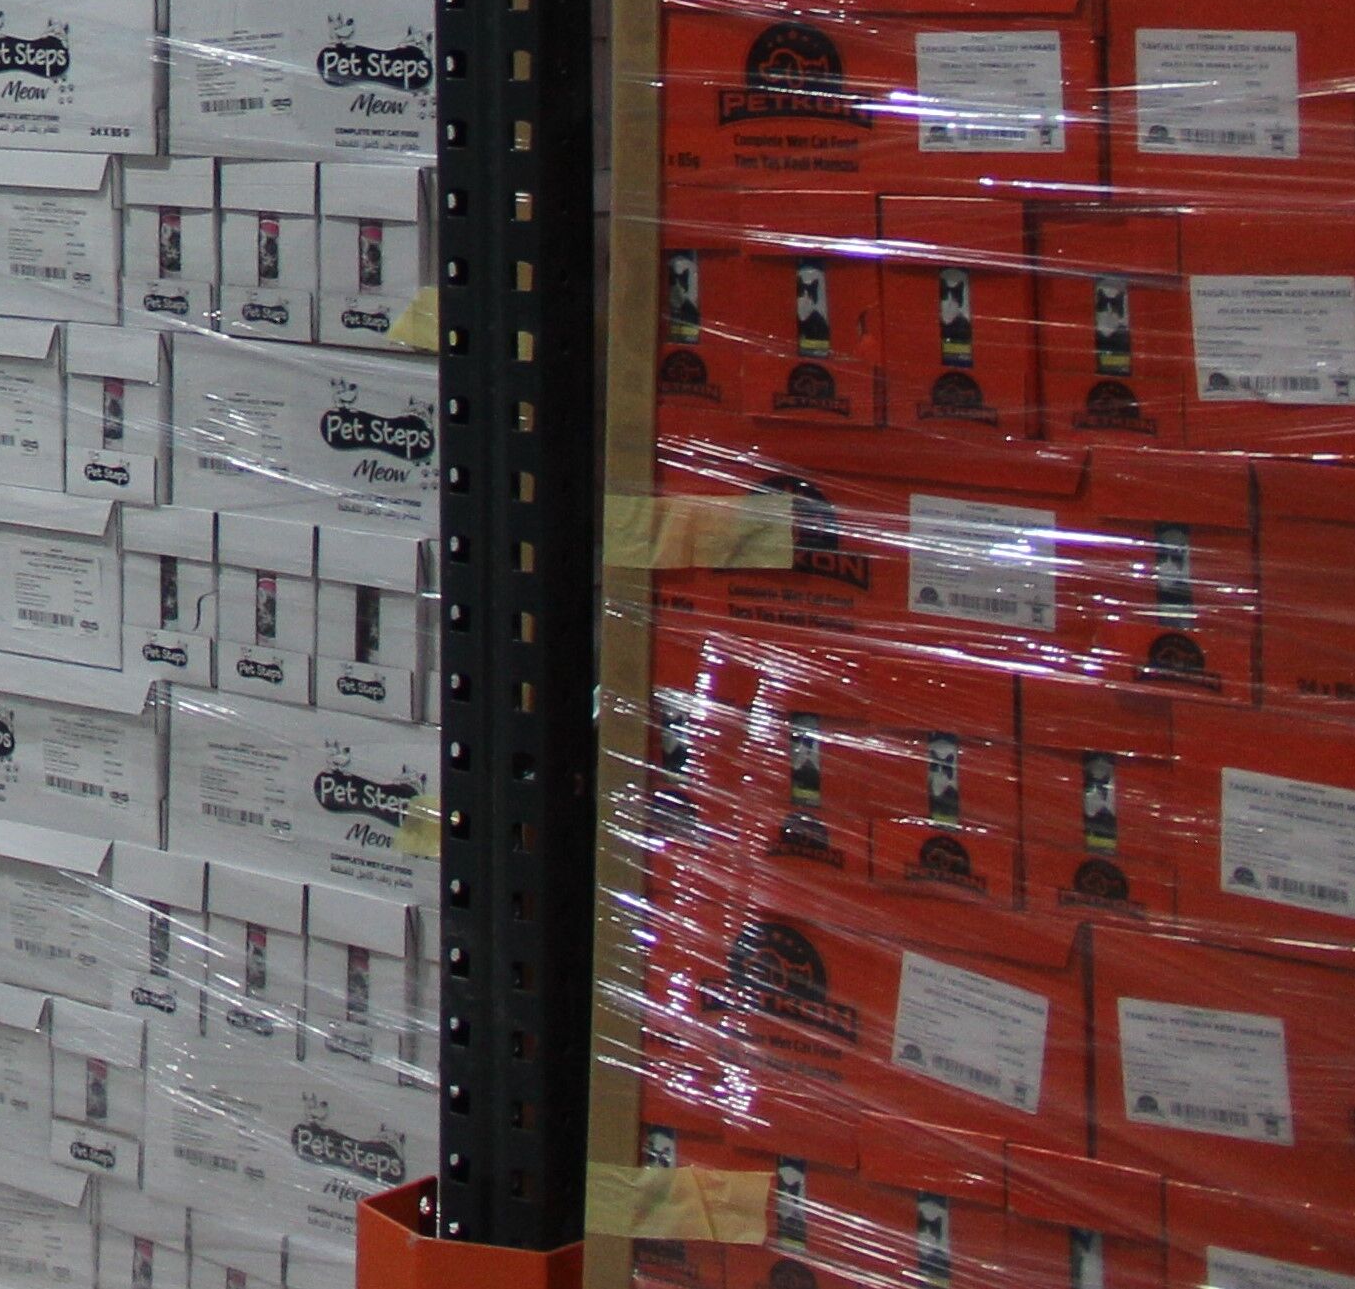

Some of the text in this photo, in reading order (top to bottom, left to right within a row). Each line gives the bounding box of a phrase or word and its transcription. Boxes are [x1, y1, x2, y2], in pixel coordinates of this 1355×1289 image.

[14, 43, 66, 76] Steps
[324, 52, 429, 89] Pet Steps
[1, 81, 49, 102] Meow
[350, 94, 408, 116] Meow
[327, 416, 430, 457] Pet Steps
[353, 459, 410, 483] Meow
[321, 778, 410, 825] Pet Step
[297, 1130, 401, 1180] Pet Steps
